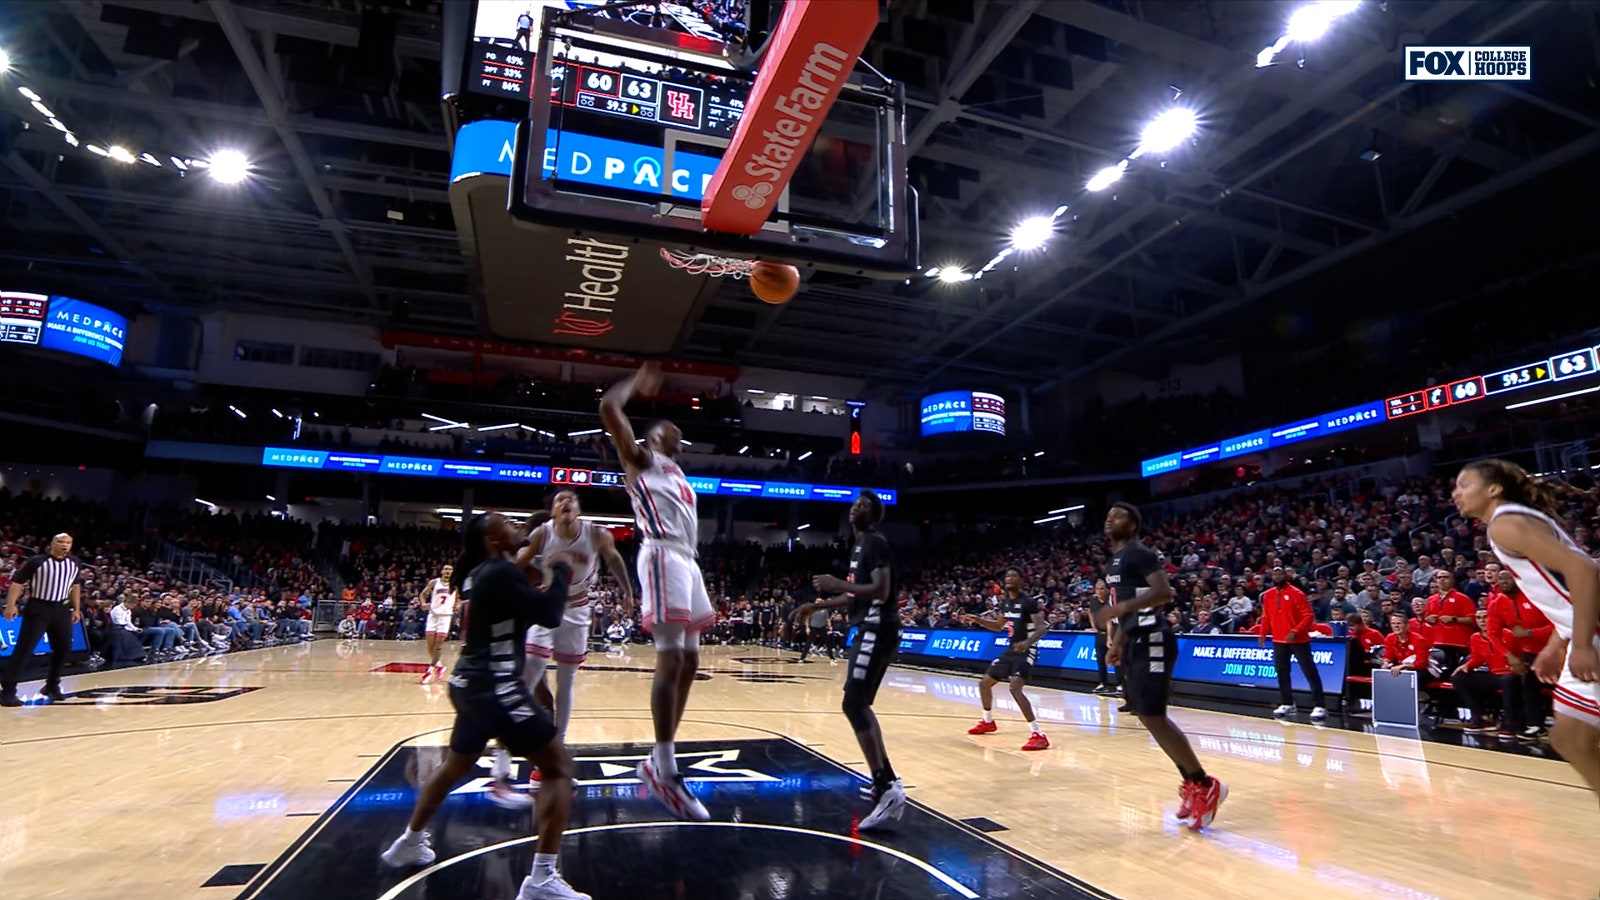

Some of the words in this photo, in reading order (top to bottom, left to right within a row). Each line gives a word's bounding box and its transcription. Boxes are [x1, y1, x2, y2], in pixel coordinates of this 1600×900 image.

[587, 73, 612, 91] 60
[627, 80, 652, 98] 63
[606, 100, 627, 112] 59.5
[57, 310, 124, 339] MEDPACE
[1559, 355, 1587, 375] 63
[1502, 370, 1531, 387] 59.5
[1455, 382, 1477, 399] 60
[923, 400, 966, 413] MEDPACE
[1327, 409, 1378, 428] MEDPACE
[1225, 437, 1264, 452] MEDPACE
[271, 454, 320, 463] MEDPACE
[387, 462, 433, 471] MEDPACE
[499, 470, 542, 479] MEDPACE
[572, 472, 587, 482] 60
[602, 475, 618, 483] 59.5
[768, 487, 805, 495] MEDPACE
[440, 596, 447, 604] 7
[932, 637, 981, 652] MEDPACE
[1193, 646, 1215, 658] MAKE
[1215, 647, 1222, 658] A
[1223, 647, 1274, 661] DIFFERENCE
[1222, 664, 1242, 675] JOIN
[1244, 665, 1256, 676] US
